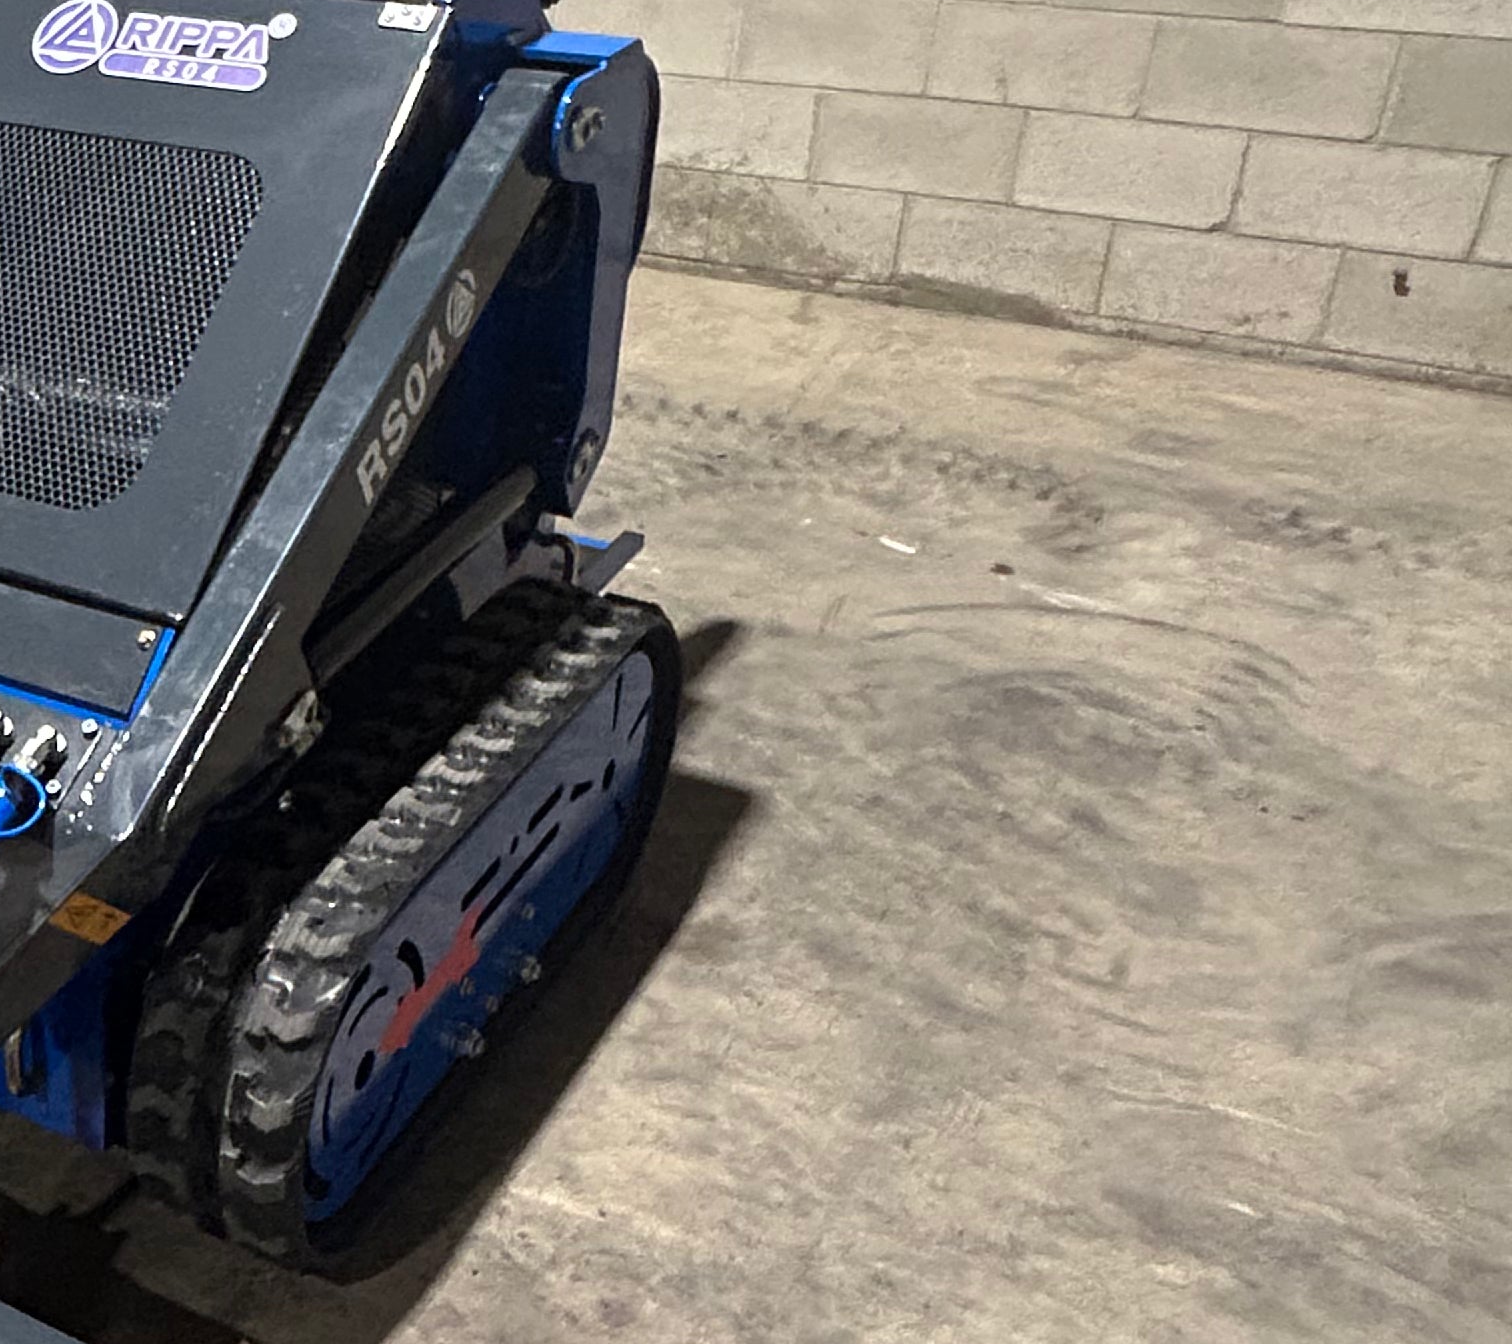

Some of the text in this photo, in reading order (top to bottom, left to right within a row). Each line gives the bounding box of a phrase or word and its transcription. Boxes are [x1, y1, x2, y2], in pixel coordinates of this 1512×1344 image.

[118, 14, 267, 62] RIPPA
[141, 57, 220, 84] RS04
[356, 325, 446, 507] RS04
